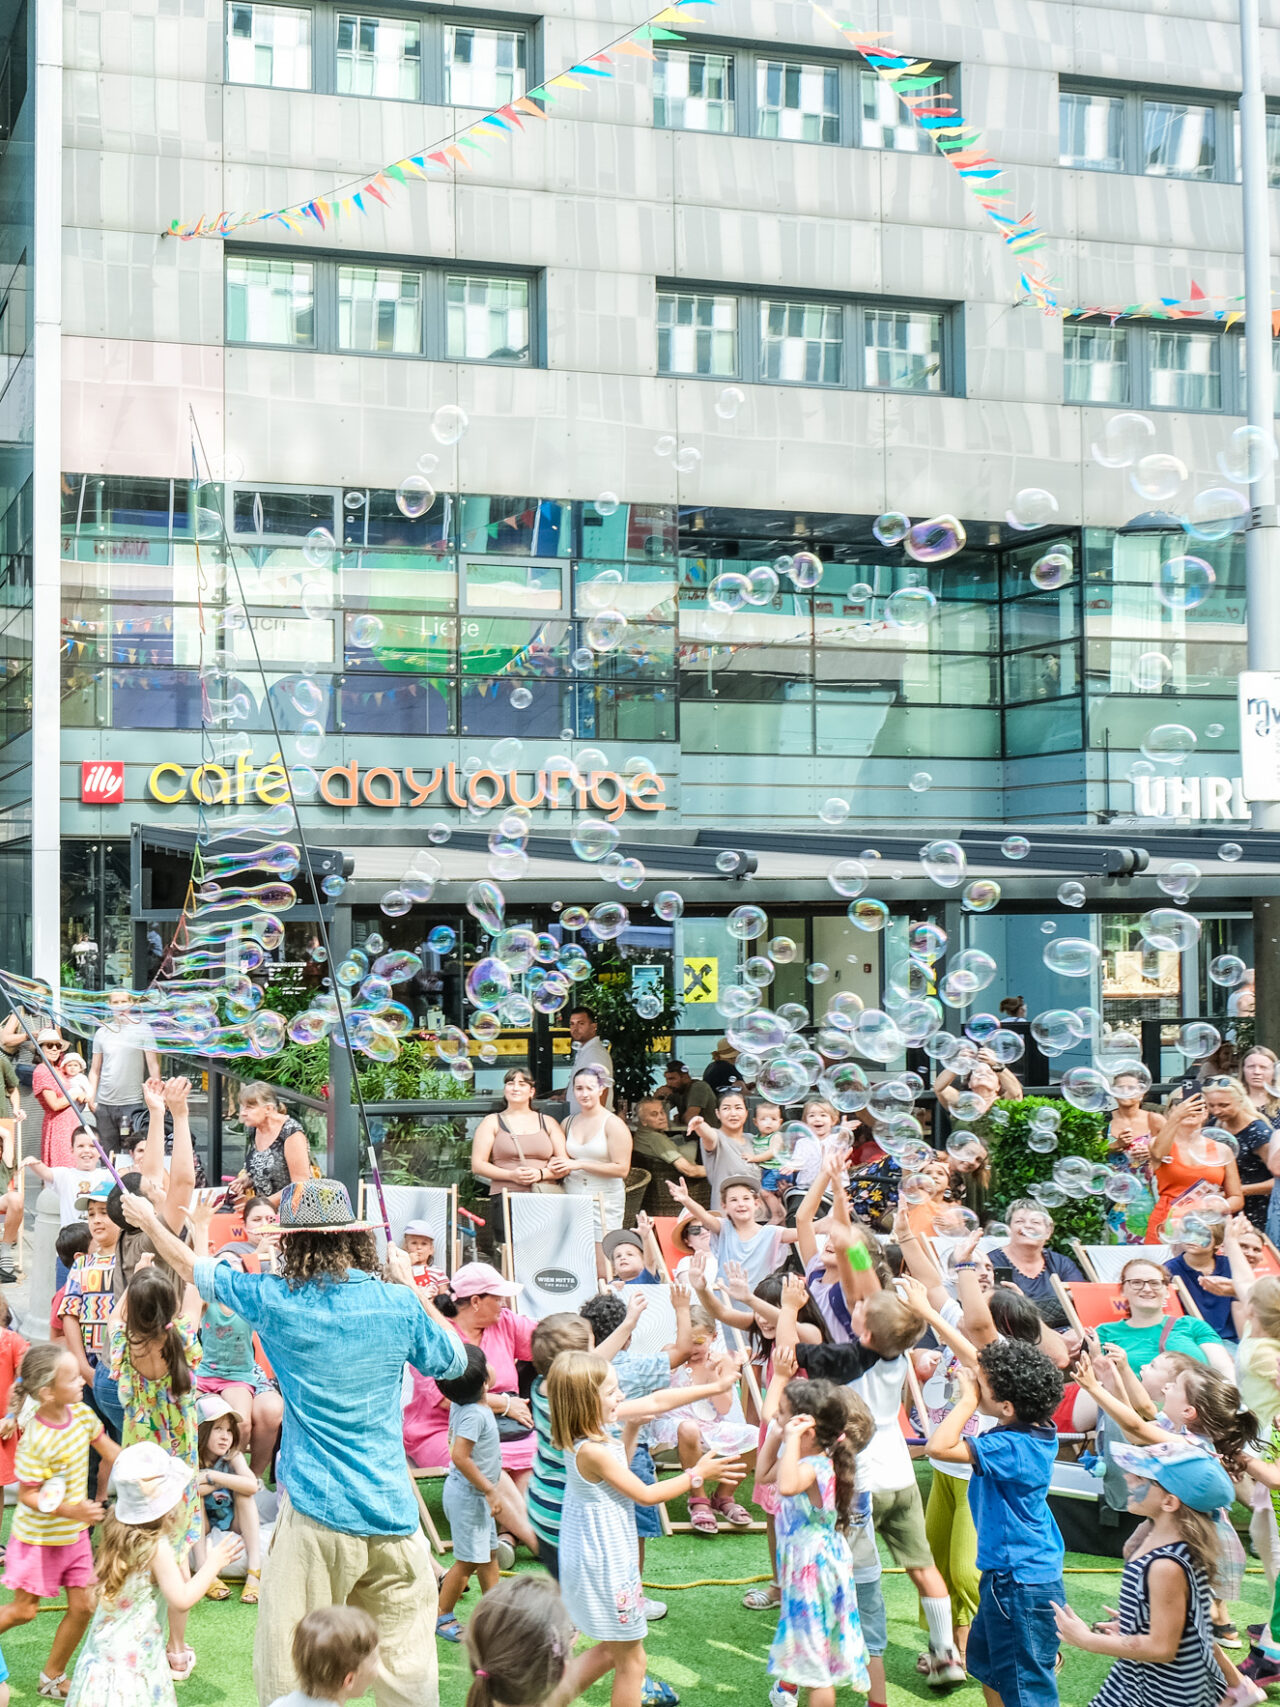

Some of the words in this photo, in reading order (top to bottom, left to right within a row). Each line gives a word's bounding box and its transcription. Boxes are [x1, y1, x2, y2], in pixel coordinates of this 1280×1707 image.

[84, 765, 123, 799] illy
[148, 749, 293, 805] café
[319, 760, 667, 822] daylounge
